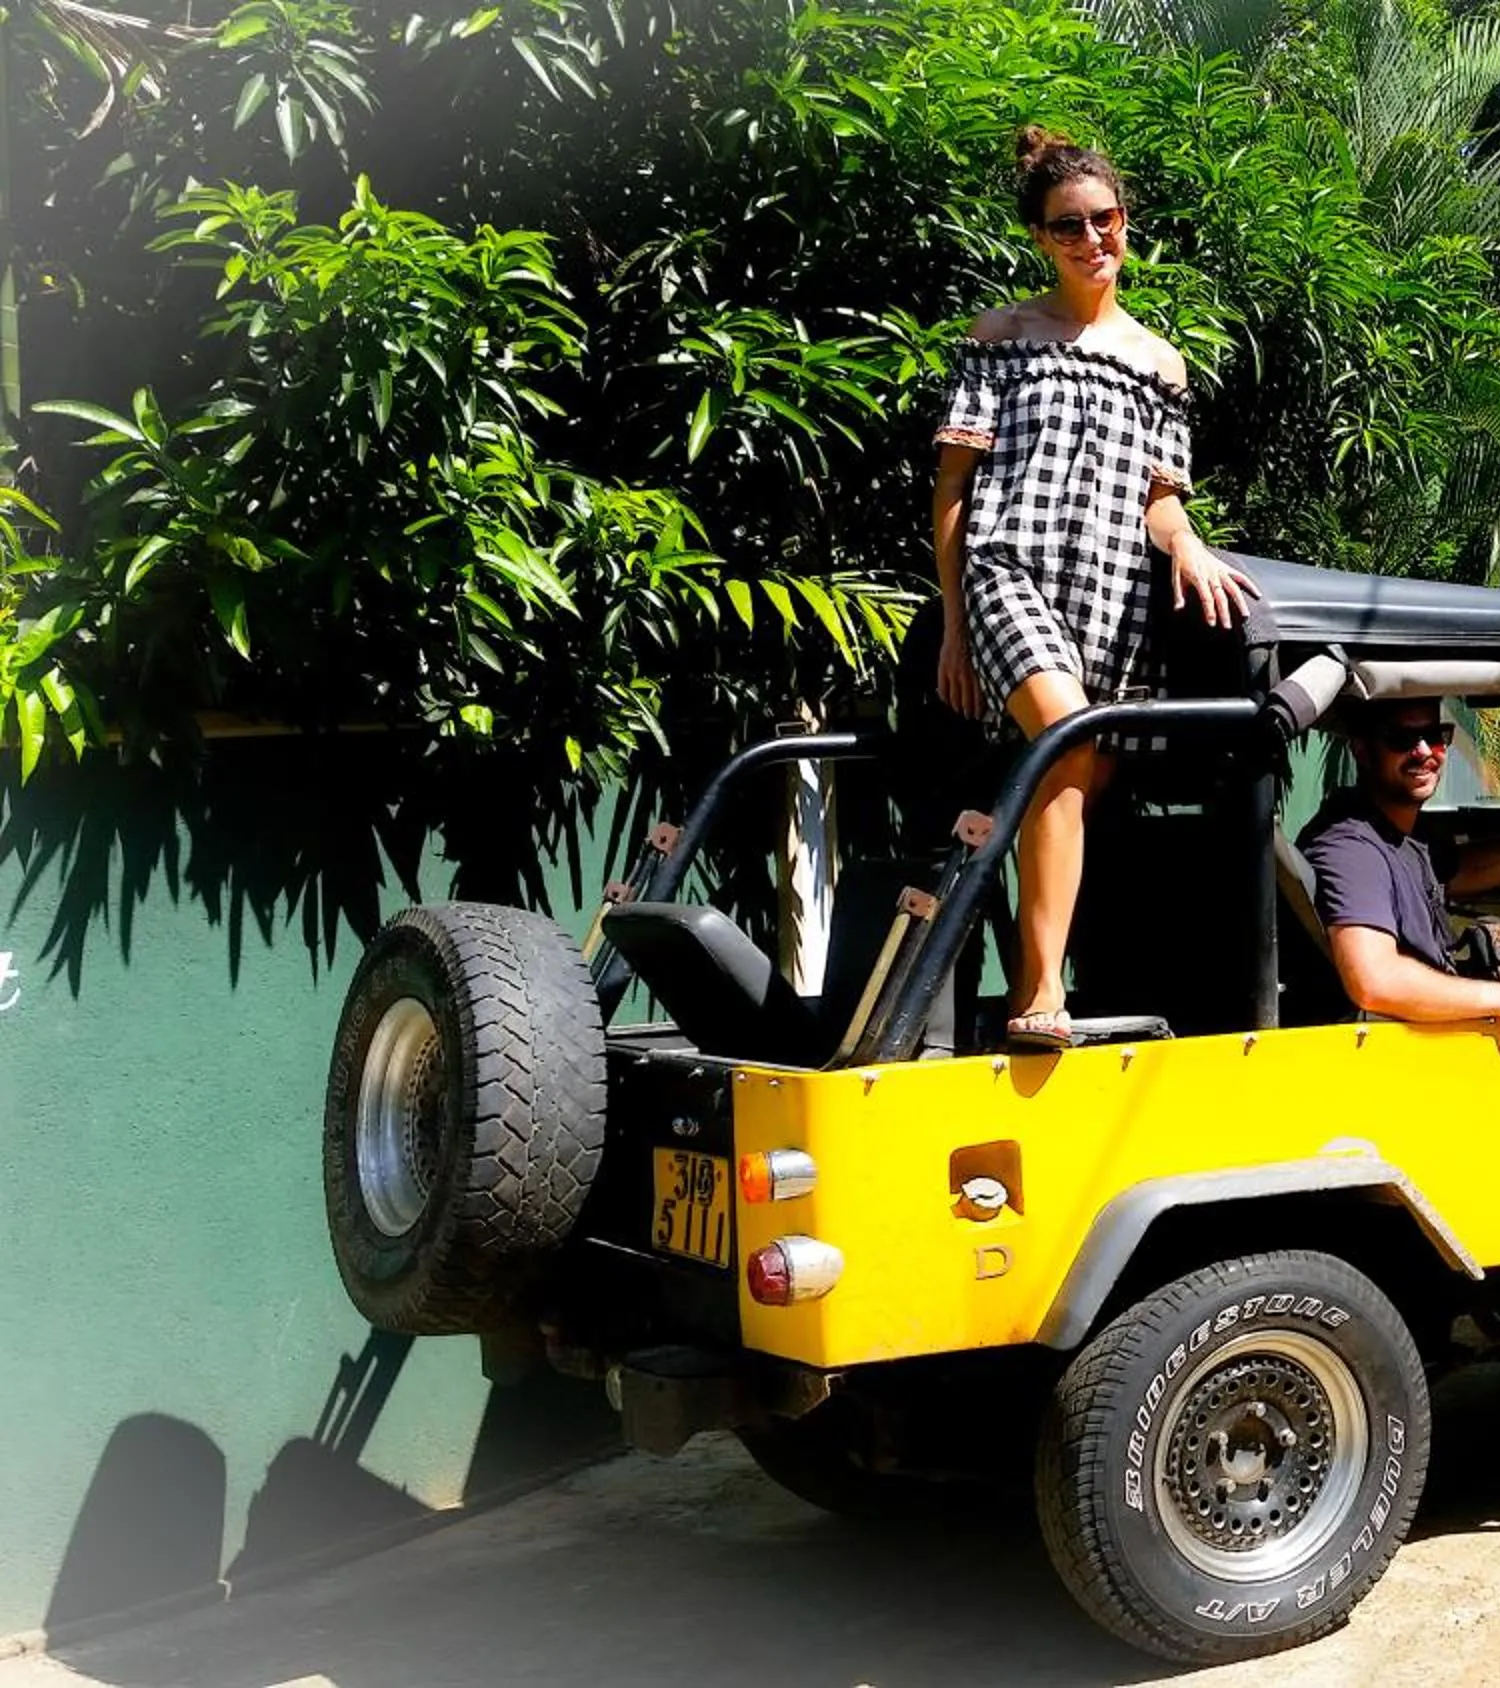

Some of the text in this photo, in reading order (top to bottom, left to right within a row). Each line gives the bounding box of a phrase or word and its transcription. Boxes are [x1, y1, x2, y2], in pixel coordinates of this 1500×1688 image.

[656, 1199, 725, 1264] 5111
[975, 1244, 1013, 1280] D
[1125, 1293, 1353, 1512] BRIDGESTONE
[1195, 1414, 1406, 1624] DUELER A/T
